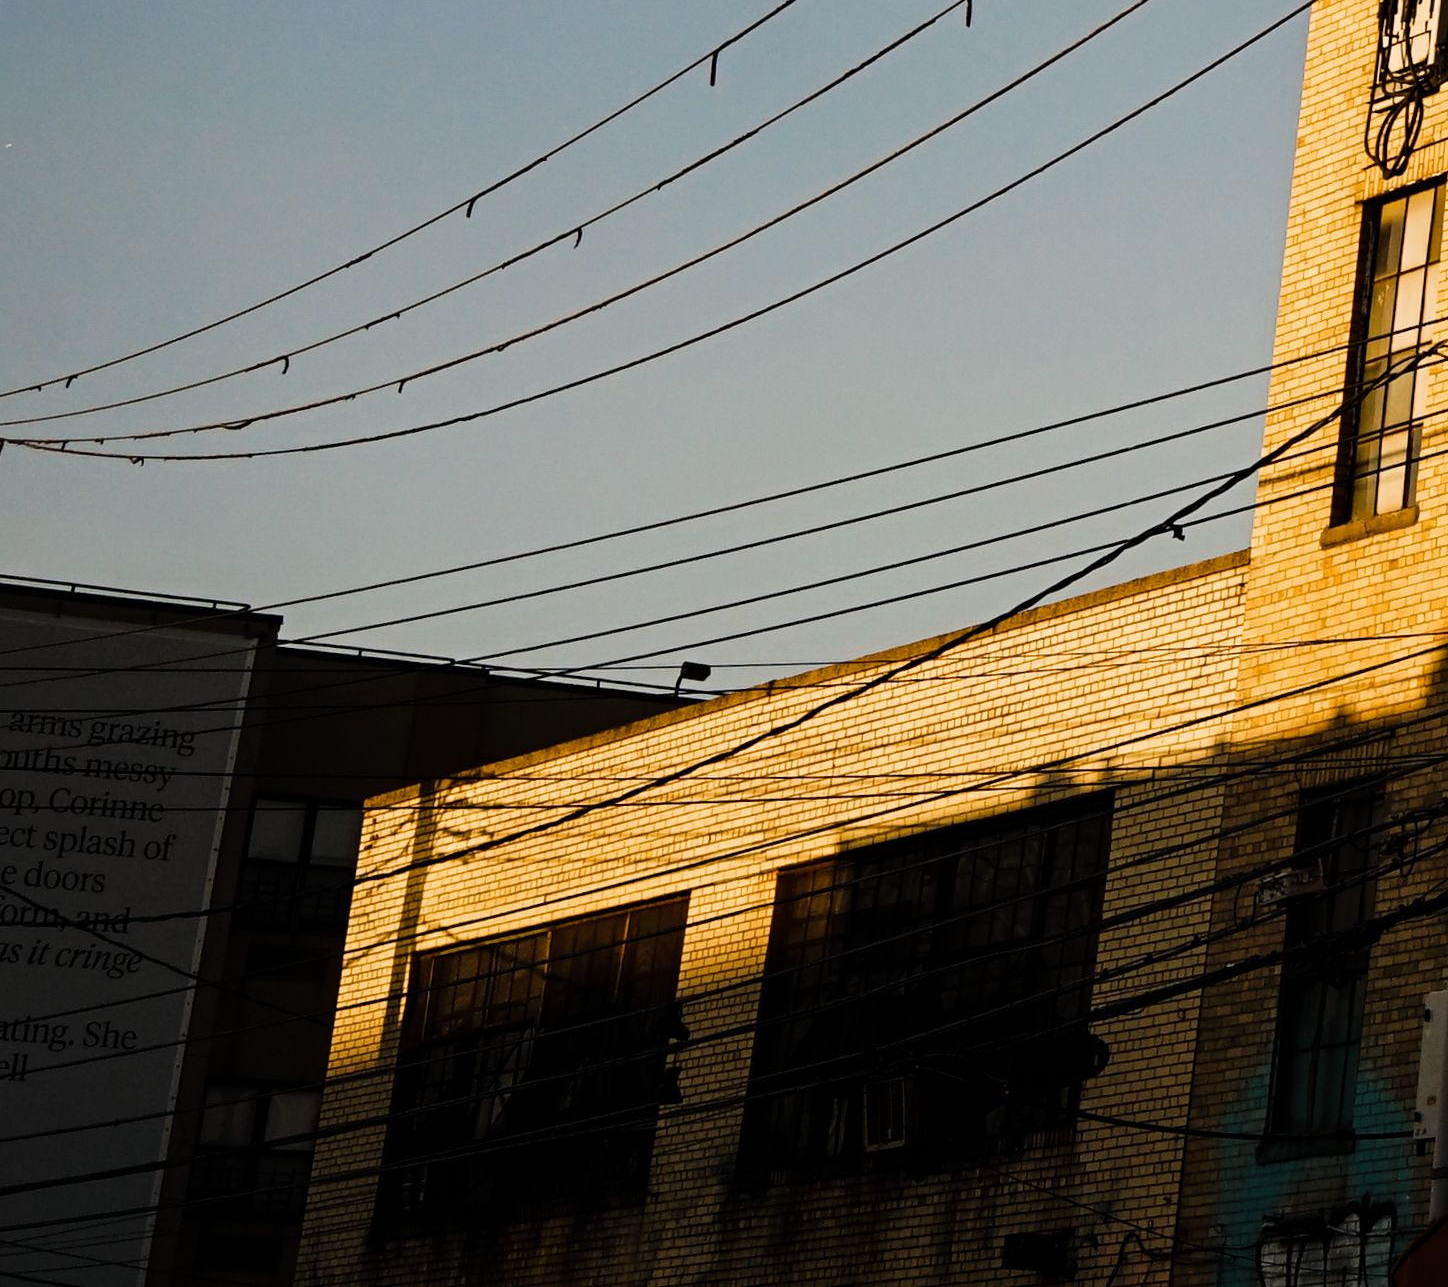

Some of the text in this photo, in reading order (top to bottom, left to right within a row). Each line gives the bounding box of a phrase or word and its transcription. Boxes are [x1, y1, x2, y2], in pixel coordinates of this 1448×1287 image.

[9, 710, 196, 758] arms grazing
[86, 757, 177, 792] messy
[49, 787, 165, 823] Corinne
[43, 826, 137, 859] splash
[143, 833, 177, 862] of
[24, 861, 106, 893] doors
[77, 907, 131, 934] and
[28, 939, 51, 965] it
[55, 943, 144, 979] cringe
[83, 1020, 138, 1050] She
